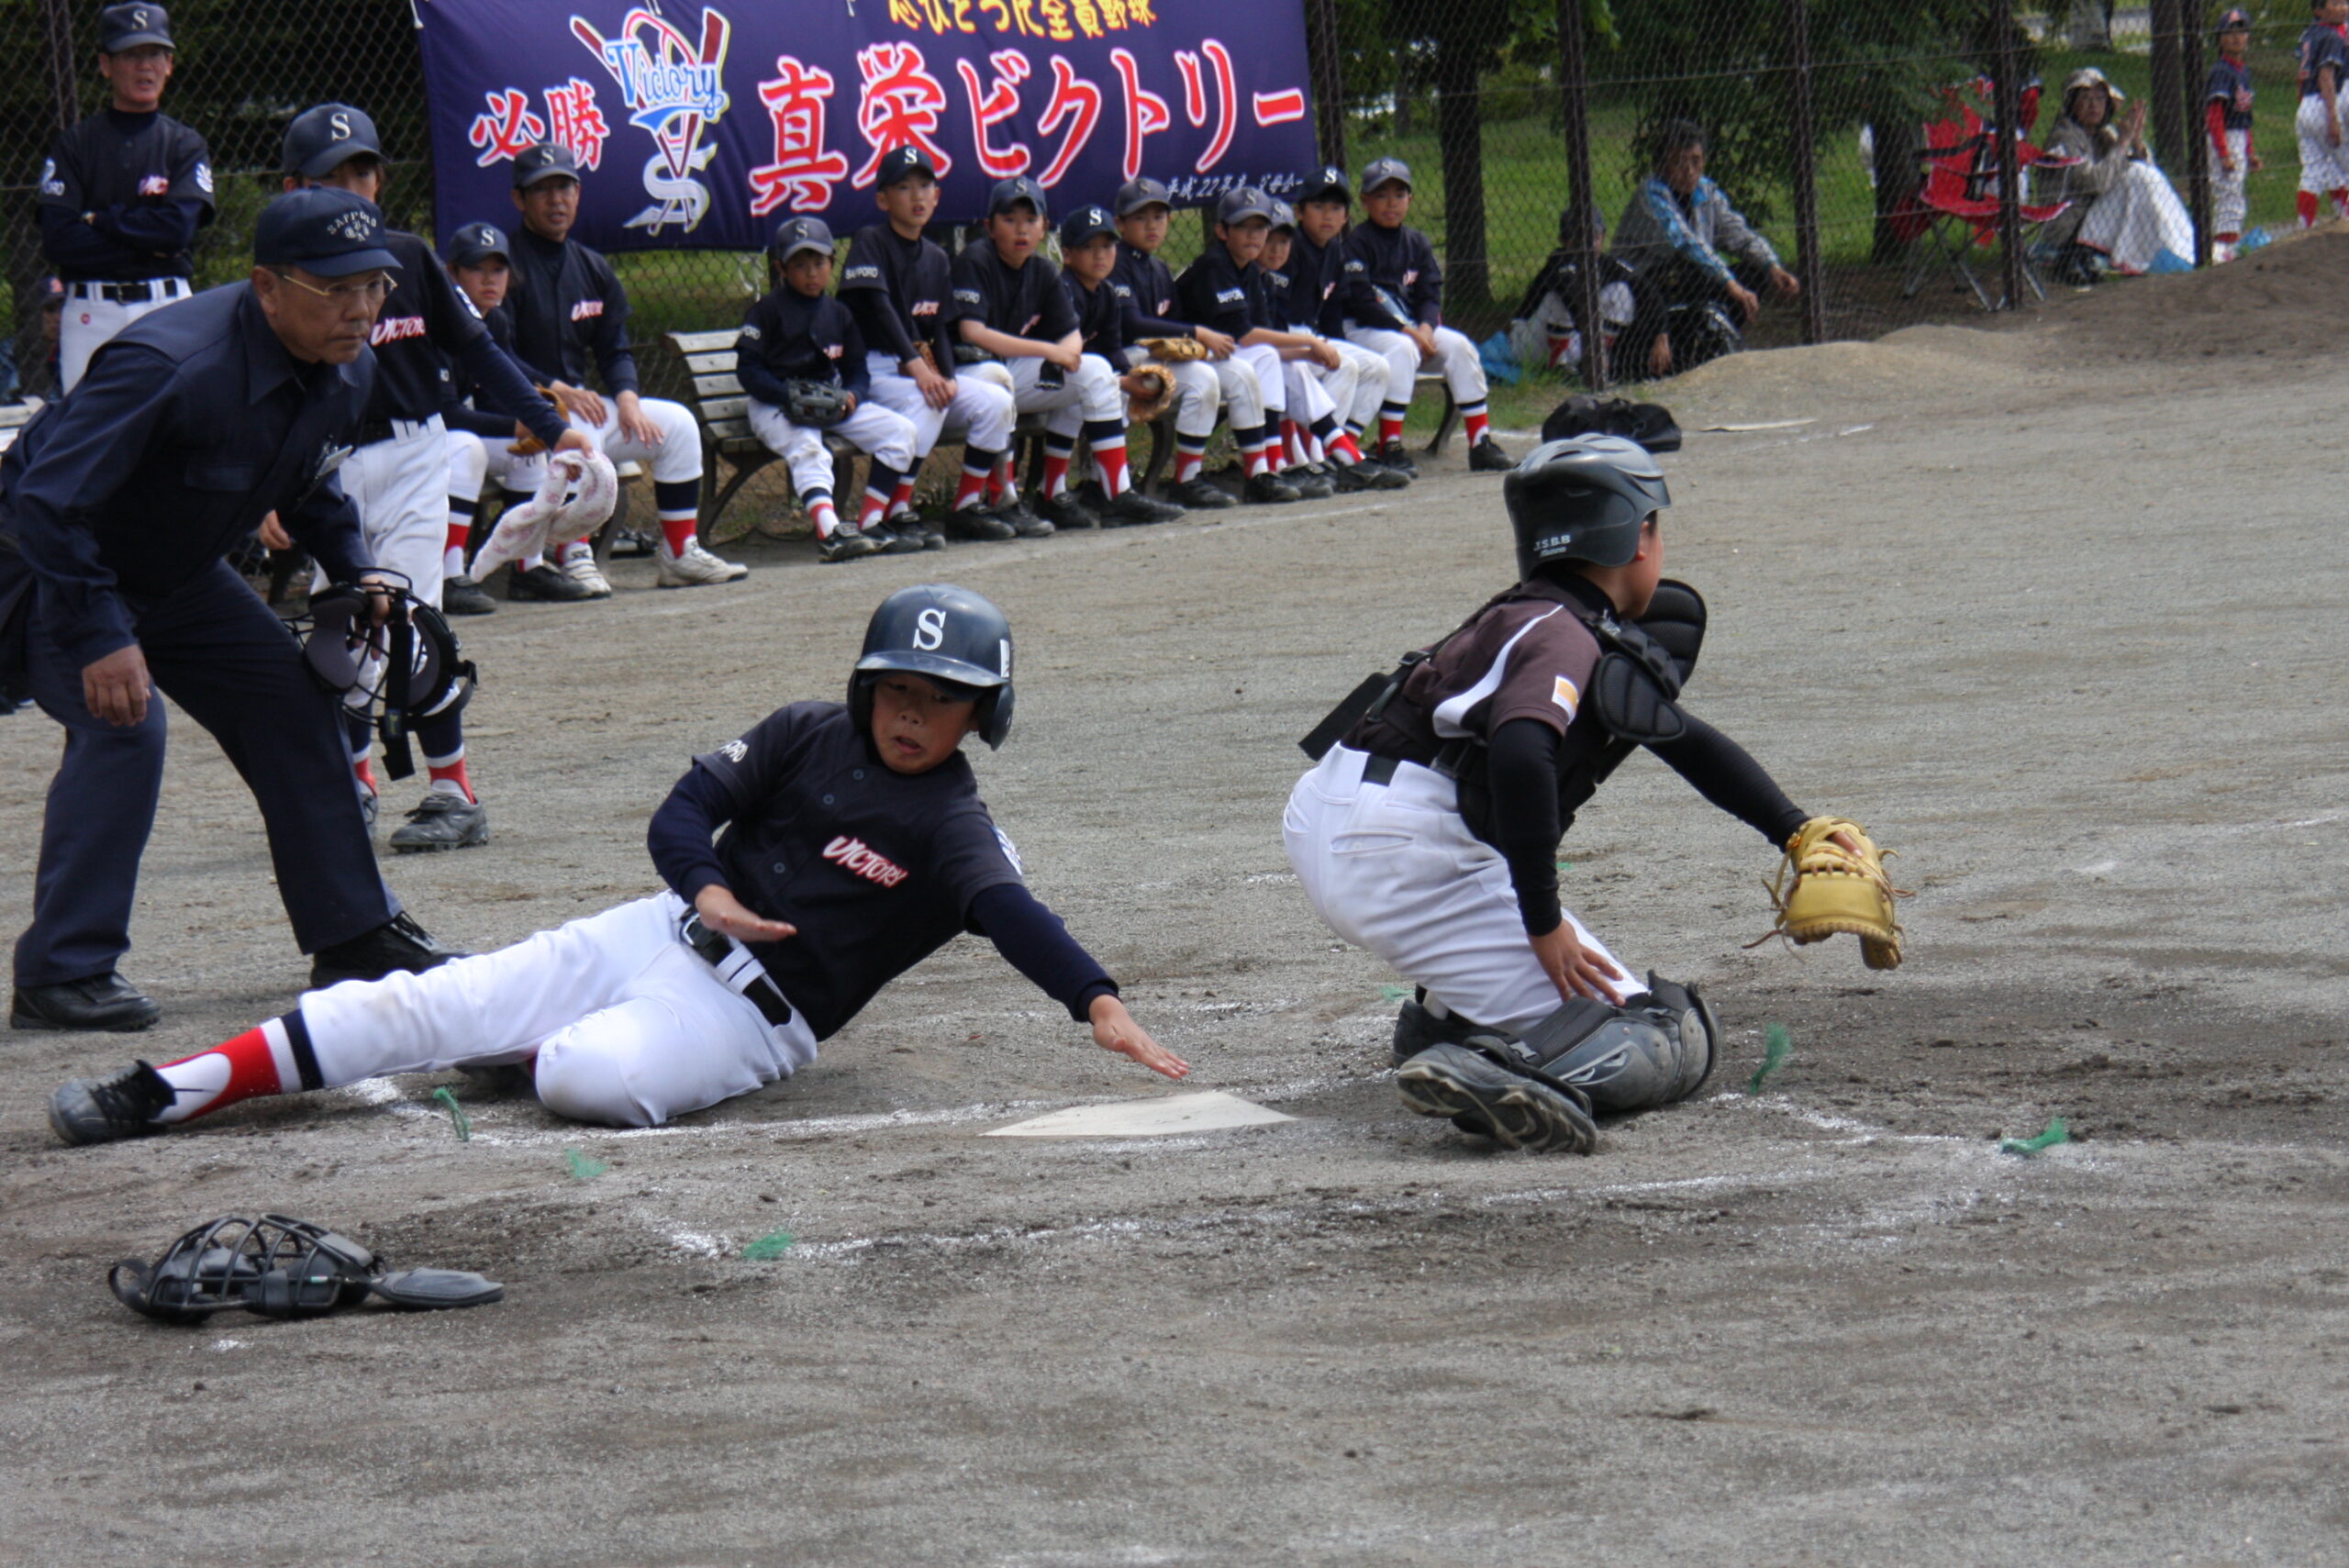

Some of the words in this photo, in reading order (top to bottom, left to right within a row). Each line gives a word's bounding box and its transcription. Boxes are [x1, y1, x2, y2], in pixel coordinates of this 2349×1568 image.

[132, 10, 148, 29] S
[600, 39, 729, 123] Victory
[330, 112, 351, 141] S
[469, 76, 610, 172] 必勝
[749, 38, 1305, 216] 真栄ビクトリー
[540, 148, 555, 167] S
[904, 148, 918, 165] S
[1324, 167, 1338, 184] S
[1015, 179, 1029, 195] S
[1089, 207, 1103, 226] S
[481, 228, 495, 247] S
[795, 224, 808, 240] S
[912, 608, 947, 651] S
[822, 835, 908, 888] VICTORY
